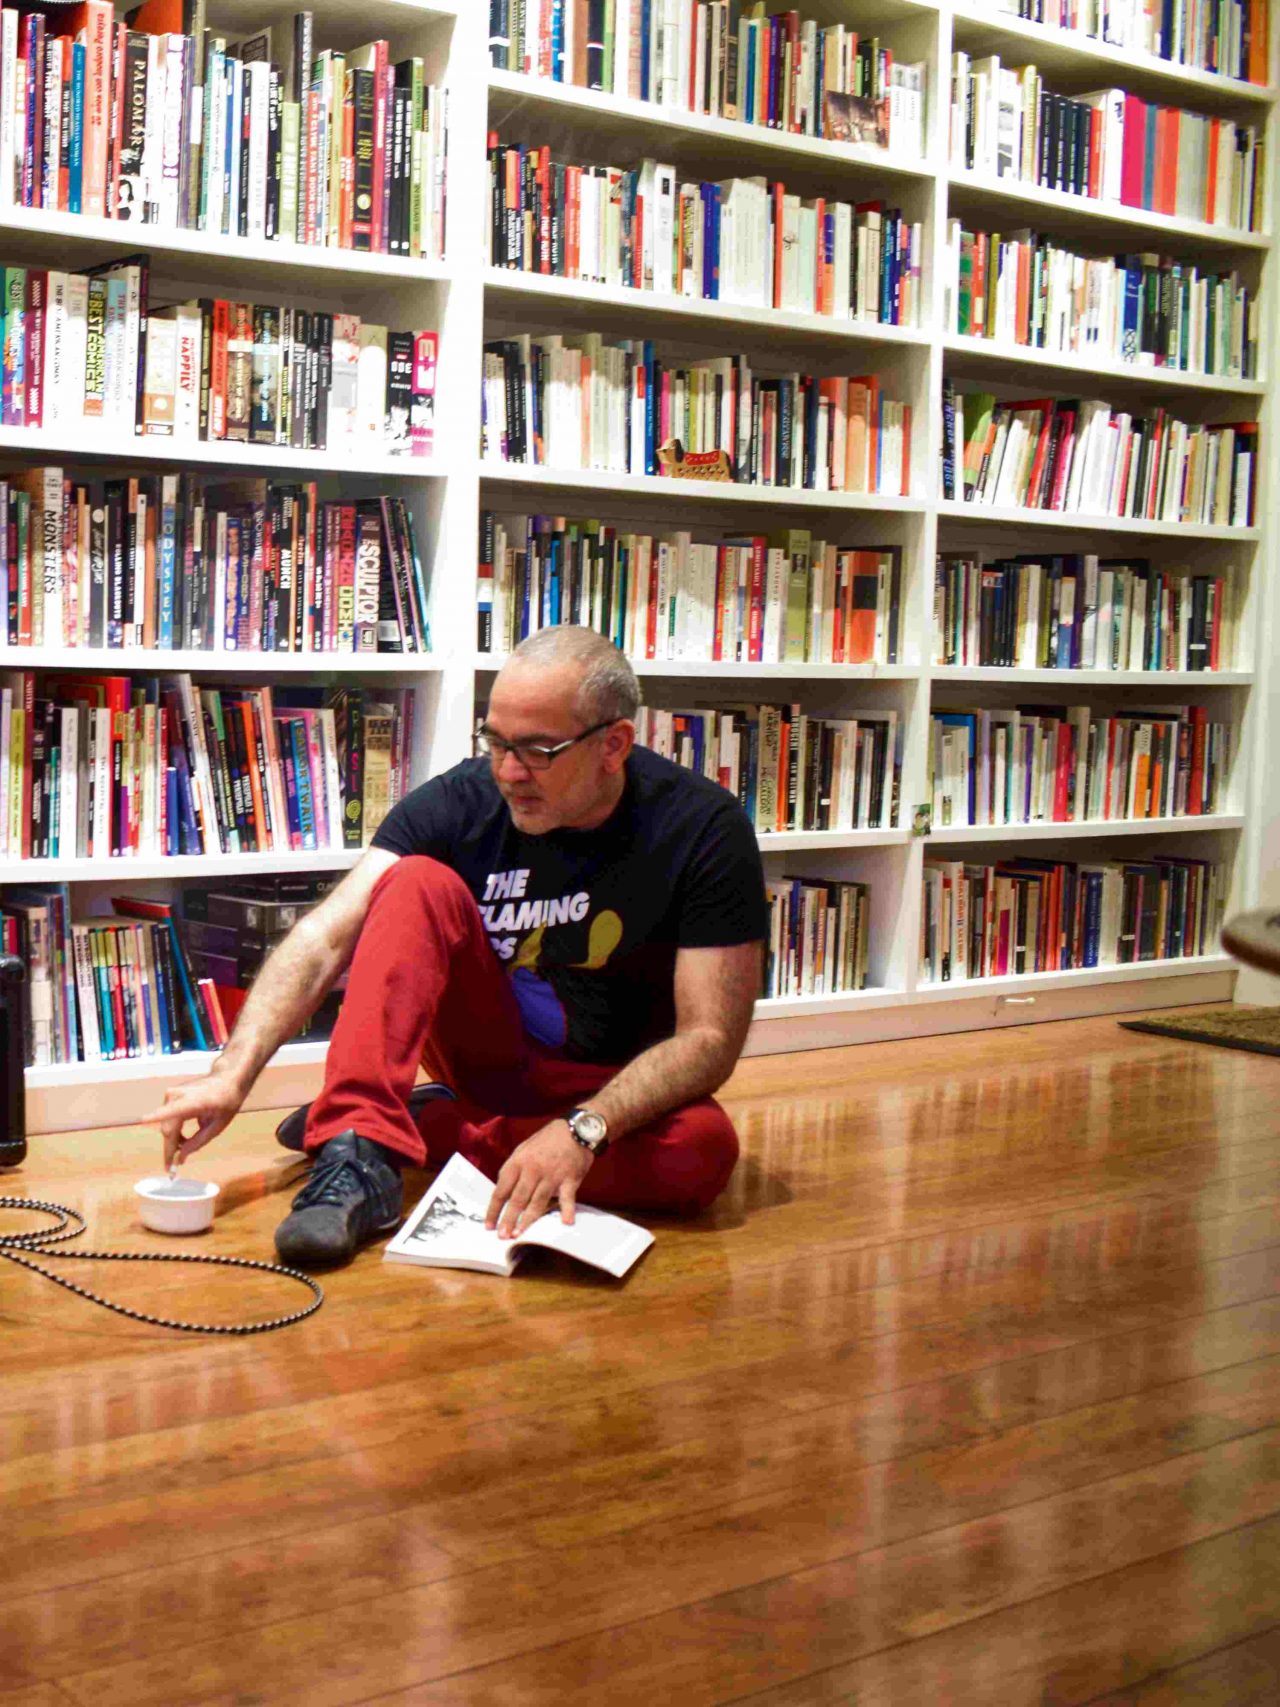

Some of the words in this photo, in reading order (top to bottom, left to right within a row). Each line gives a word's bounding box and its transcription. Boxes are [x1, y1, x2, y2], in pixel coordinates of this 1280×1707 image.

[130, 59, 147, 147] PALOMAR
[385, 114, 394, 135] THE
[309, 119, 319, 149] CLYDE
[383, 136, 394, 181] ARRIVAL
[87, 299, 105, 336] BEST
[11, 327, 23, 358] COMICS
[85, 331, 98, 394] COMICS
[95, 334, 107, 393] AMERICAN
[43, 509, 58, 595] MONSTERS
[113, 543, 123, 576] ROLLING
[279, 548, 293, 591] MUNCH
[752, 545, 762, 588] SOMERSAULT
[357, 544, 382, 624] SCULPTOR
[295, 726, 309, 781] SAILOR
[232, 779, 245, 815] PERSEPOLIS
[241, 774, 253, 808] PERSEPOLIS
[300, 782, 315, 834] TWAIN
[481, 867, 531, 902] THE
[489, 936, 519, 961] PS
